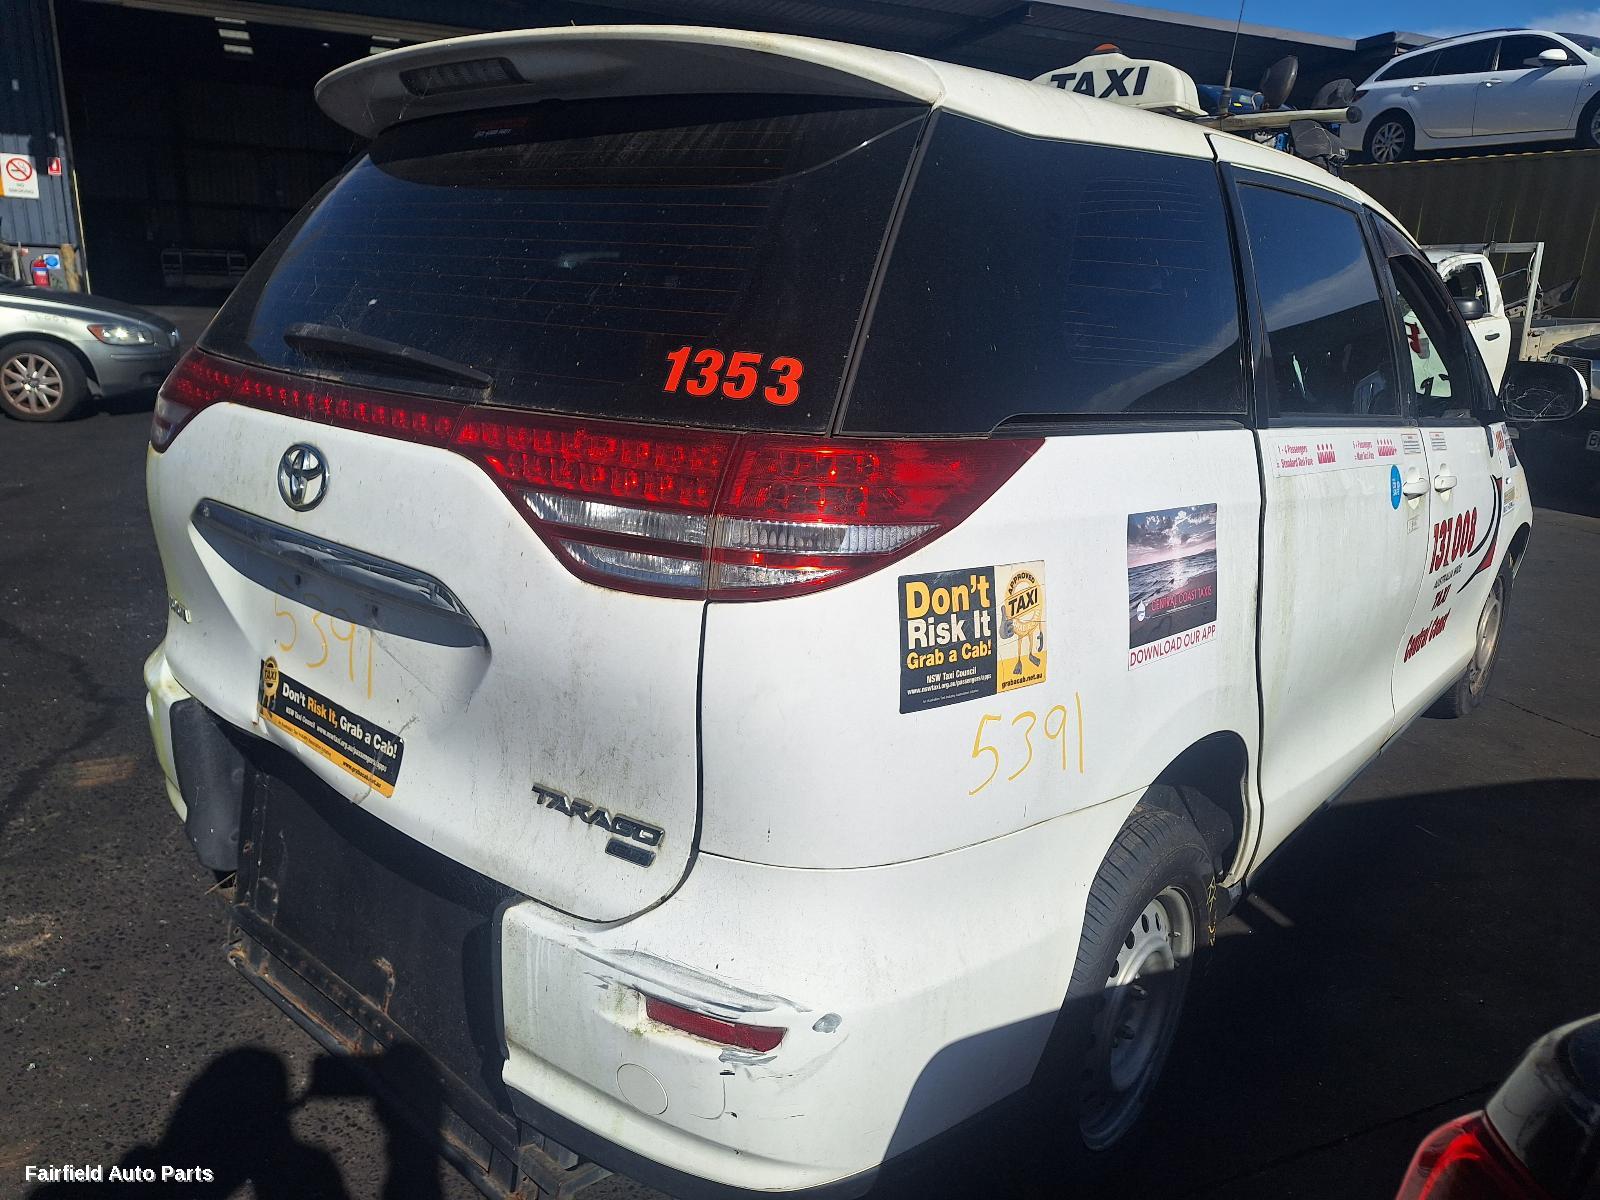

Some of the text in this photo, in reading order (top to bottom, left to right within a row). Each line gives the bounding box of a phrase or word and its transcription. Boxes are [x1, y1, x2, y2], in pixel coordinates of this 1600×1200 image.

[1050, 66, 1149, 98] TAXI
[663, 346, 804, 406] 1353
[1428, 507, 1478, 575] 131 008
[905, 574, 991, 619] Don't
[1008, 572, 1036, 596] APPROVED
[1008, 587, 1038, 617] TAXI
[1151, 597, 1178, 611] CENTRAL
[1178, 589, 1198, 604] COAST
[274, 580, 374, 700] 5391
[907, 609, 991, 650] Risk It
[1130, 624, 1216, 667] DOWNLOAD OUR APP
[264, 668, 278, 680] TAXI
[906, 639, 992, 670] Grab a Cab!
[926, 667, 977, 684] NSW Taxi Council
[282, 682, 306, 707] Don't
[307, 696, 328, 720] Risk
[339, 715, 363, 741] Grab
[364, 733, 372, 745] a
[373, 734, 398, 759] Cab!
[968, 691, 1085, 796] 5391
[531, 782, 665, 847] TARAGO
